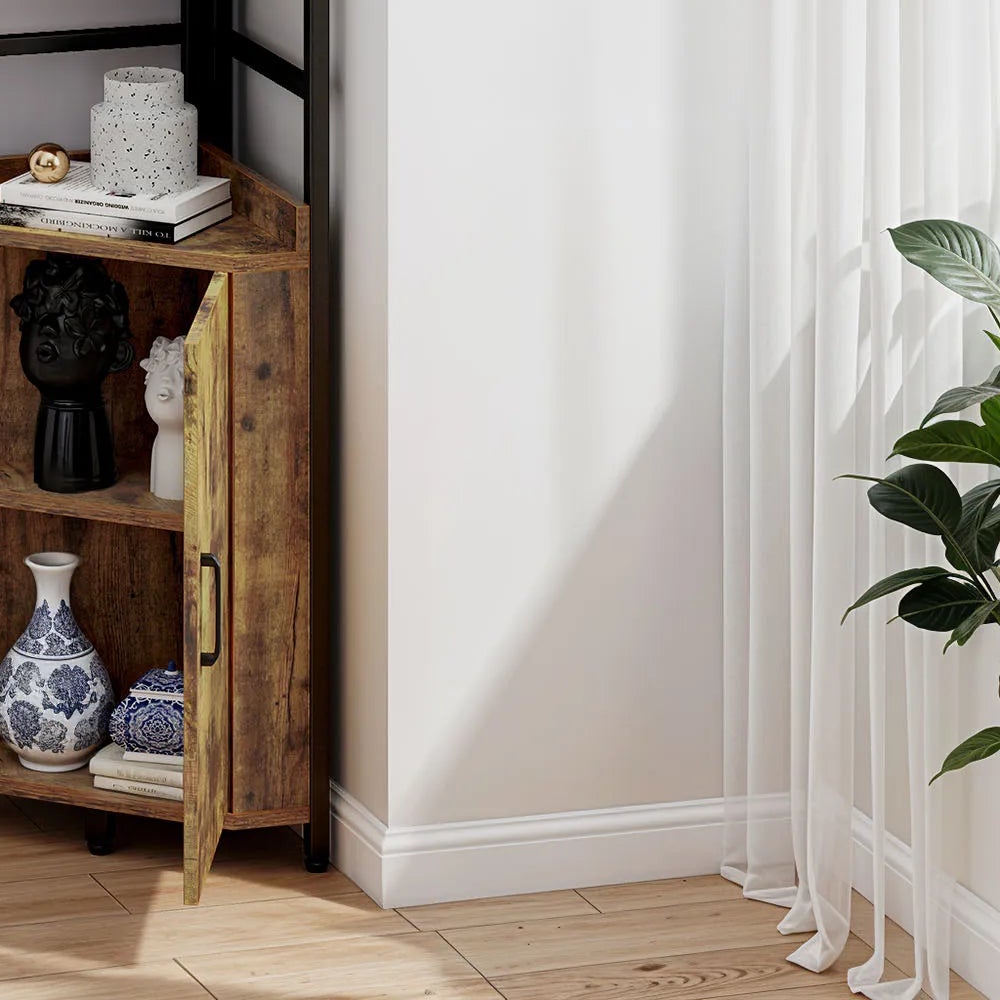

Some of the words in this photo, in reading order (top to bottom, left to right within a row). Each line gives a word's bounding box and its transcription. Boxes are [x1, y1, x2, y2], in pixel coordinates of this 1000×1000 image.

[74, 199, 104, 208] ORGANIZER
[105, 202, 129, 210] WEDDING
[40, 217, 118, 233] MOCKINGBIRD
[132, 227, 152, 237] KILL
[155, 231, 170, 239] TO
